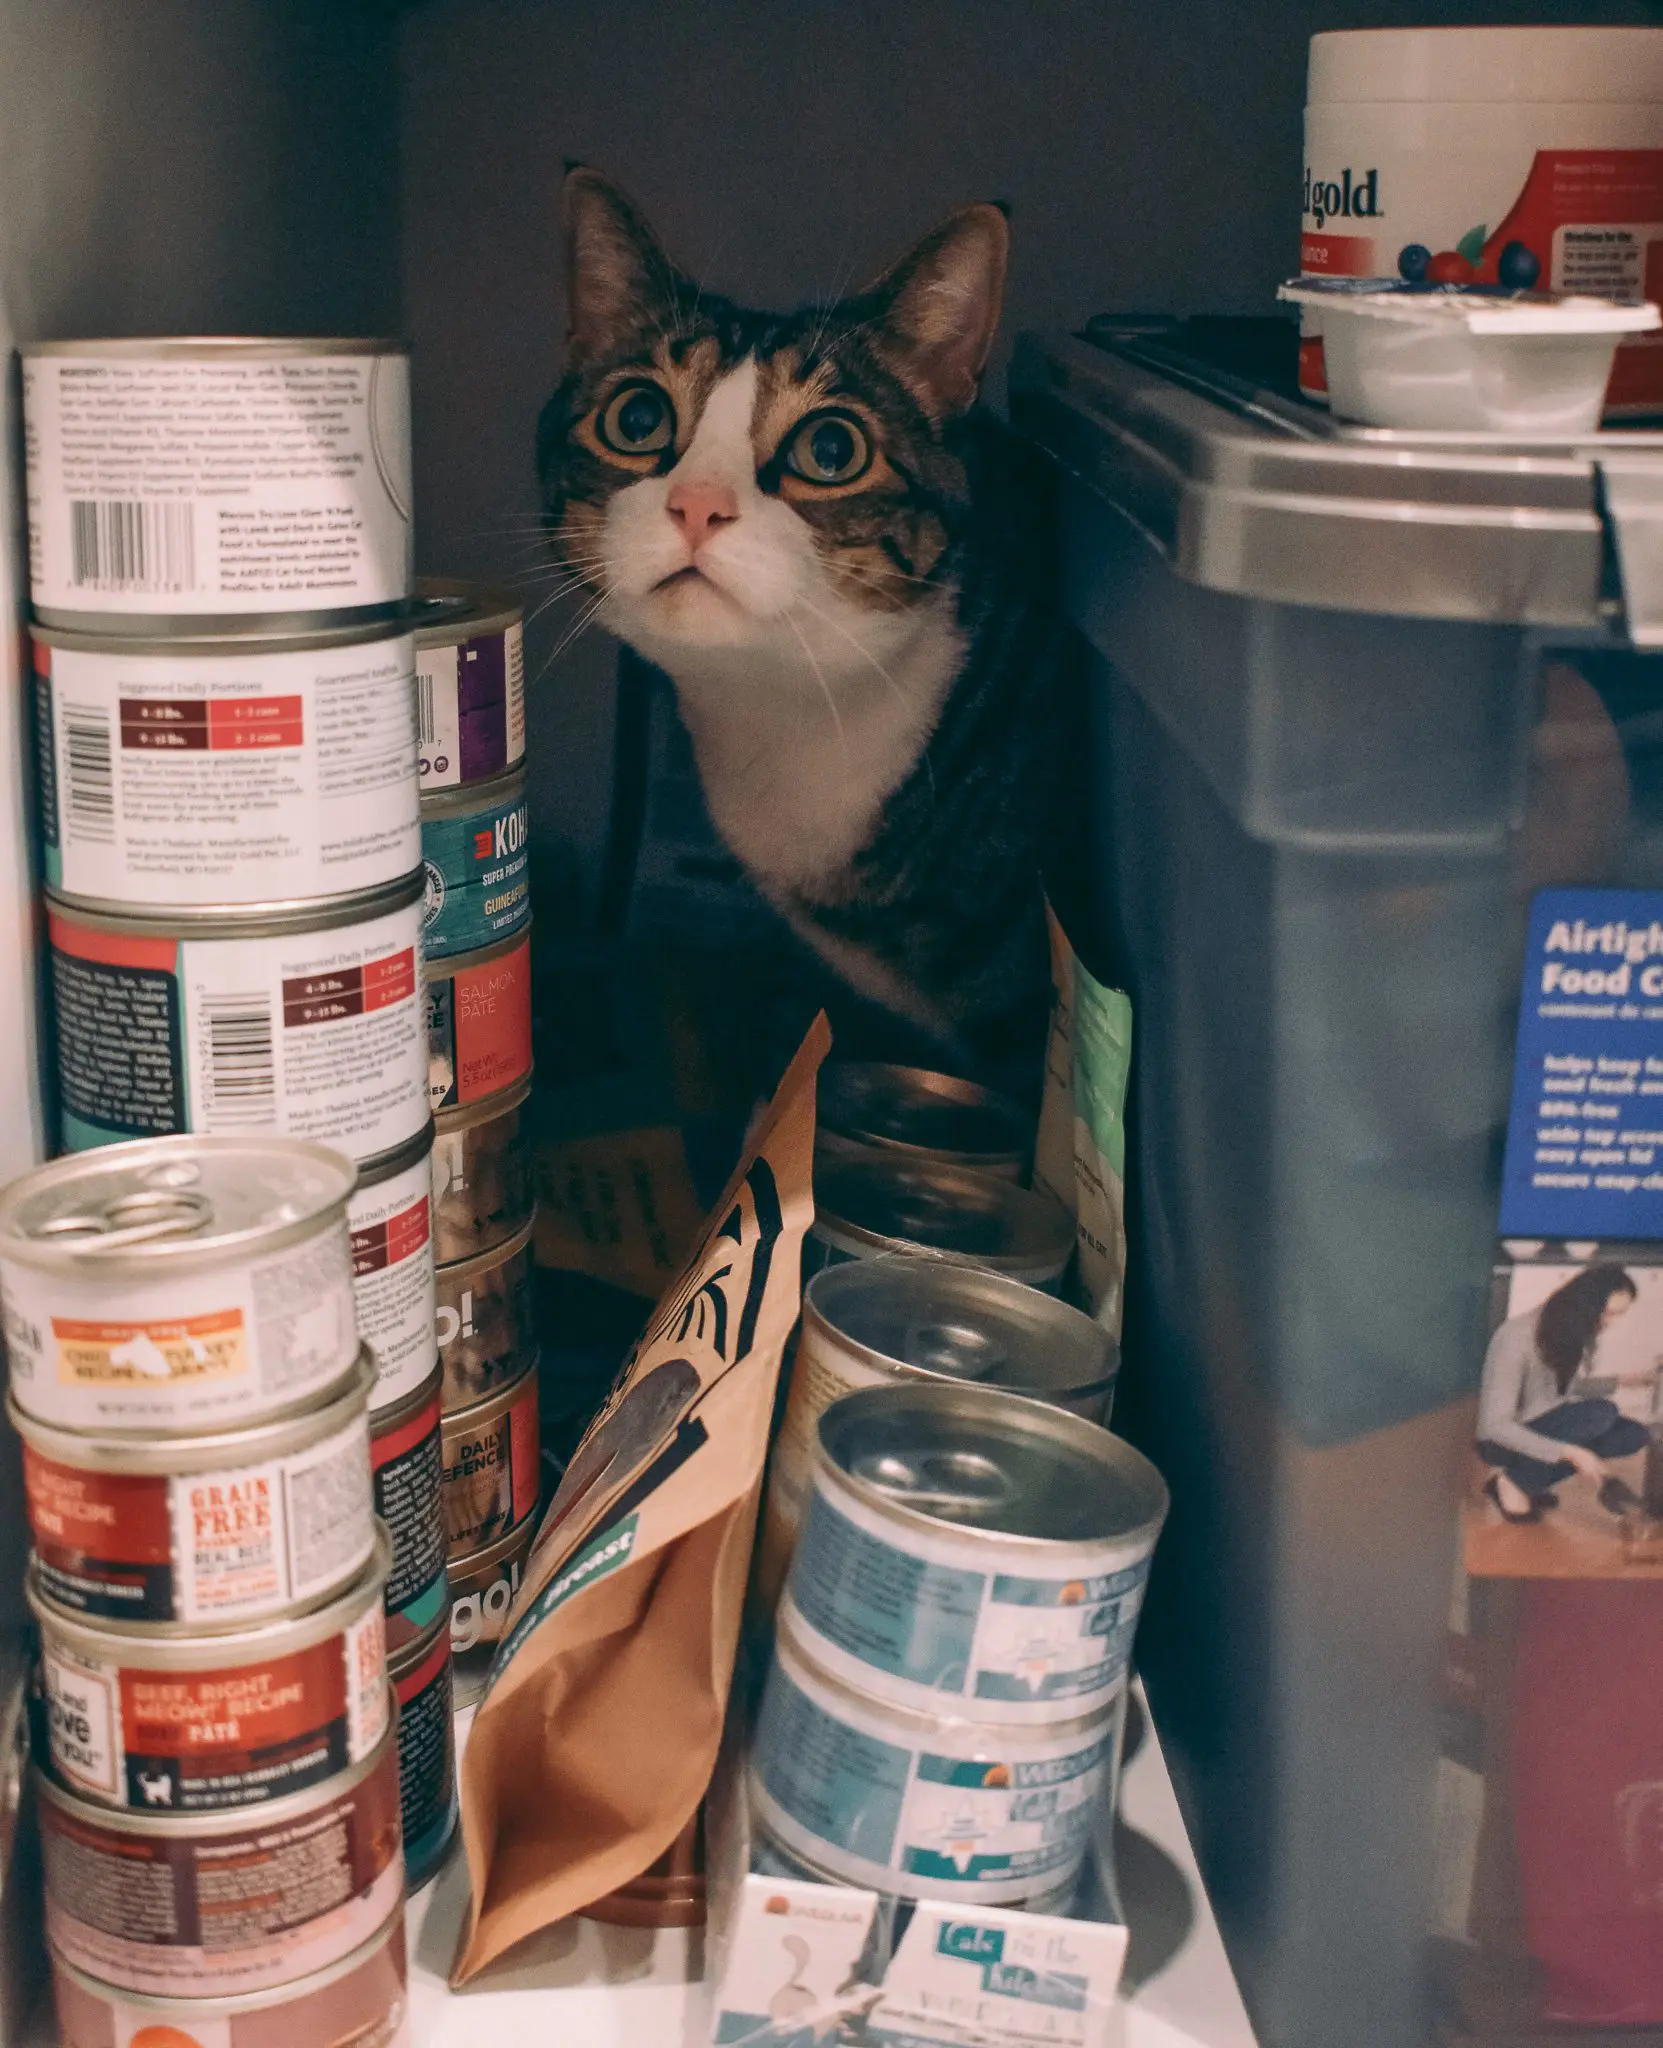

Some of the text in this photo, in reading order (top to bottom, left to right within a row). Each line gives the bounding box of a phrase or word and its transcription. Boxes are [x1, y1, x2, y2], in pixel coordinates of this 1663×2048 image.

[460, 971, 515, 1004] SALMON
[1541, 961, 1630, 996] Food
[433, 1291, 474, 1347] o!
[461, 1432, 503, 1459] DAILY
[440, 1445, 505, 1485] EFENCE
[190, 1478, 268, 1508] GRAIN
[194, 1502, 271, 1537] FREE
[450, 1561, 519, 1653] go!
